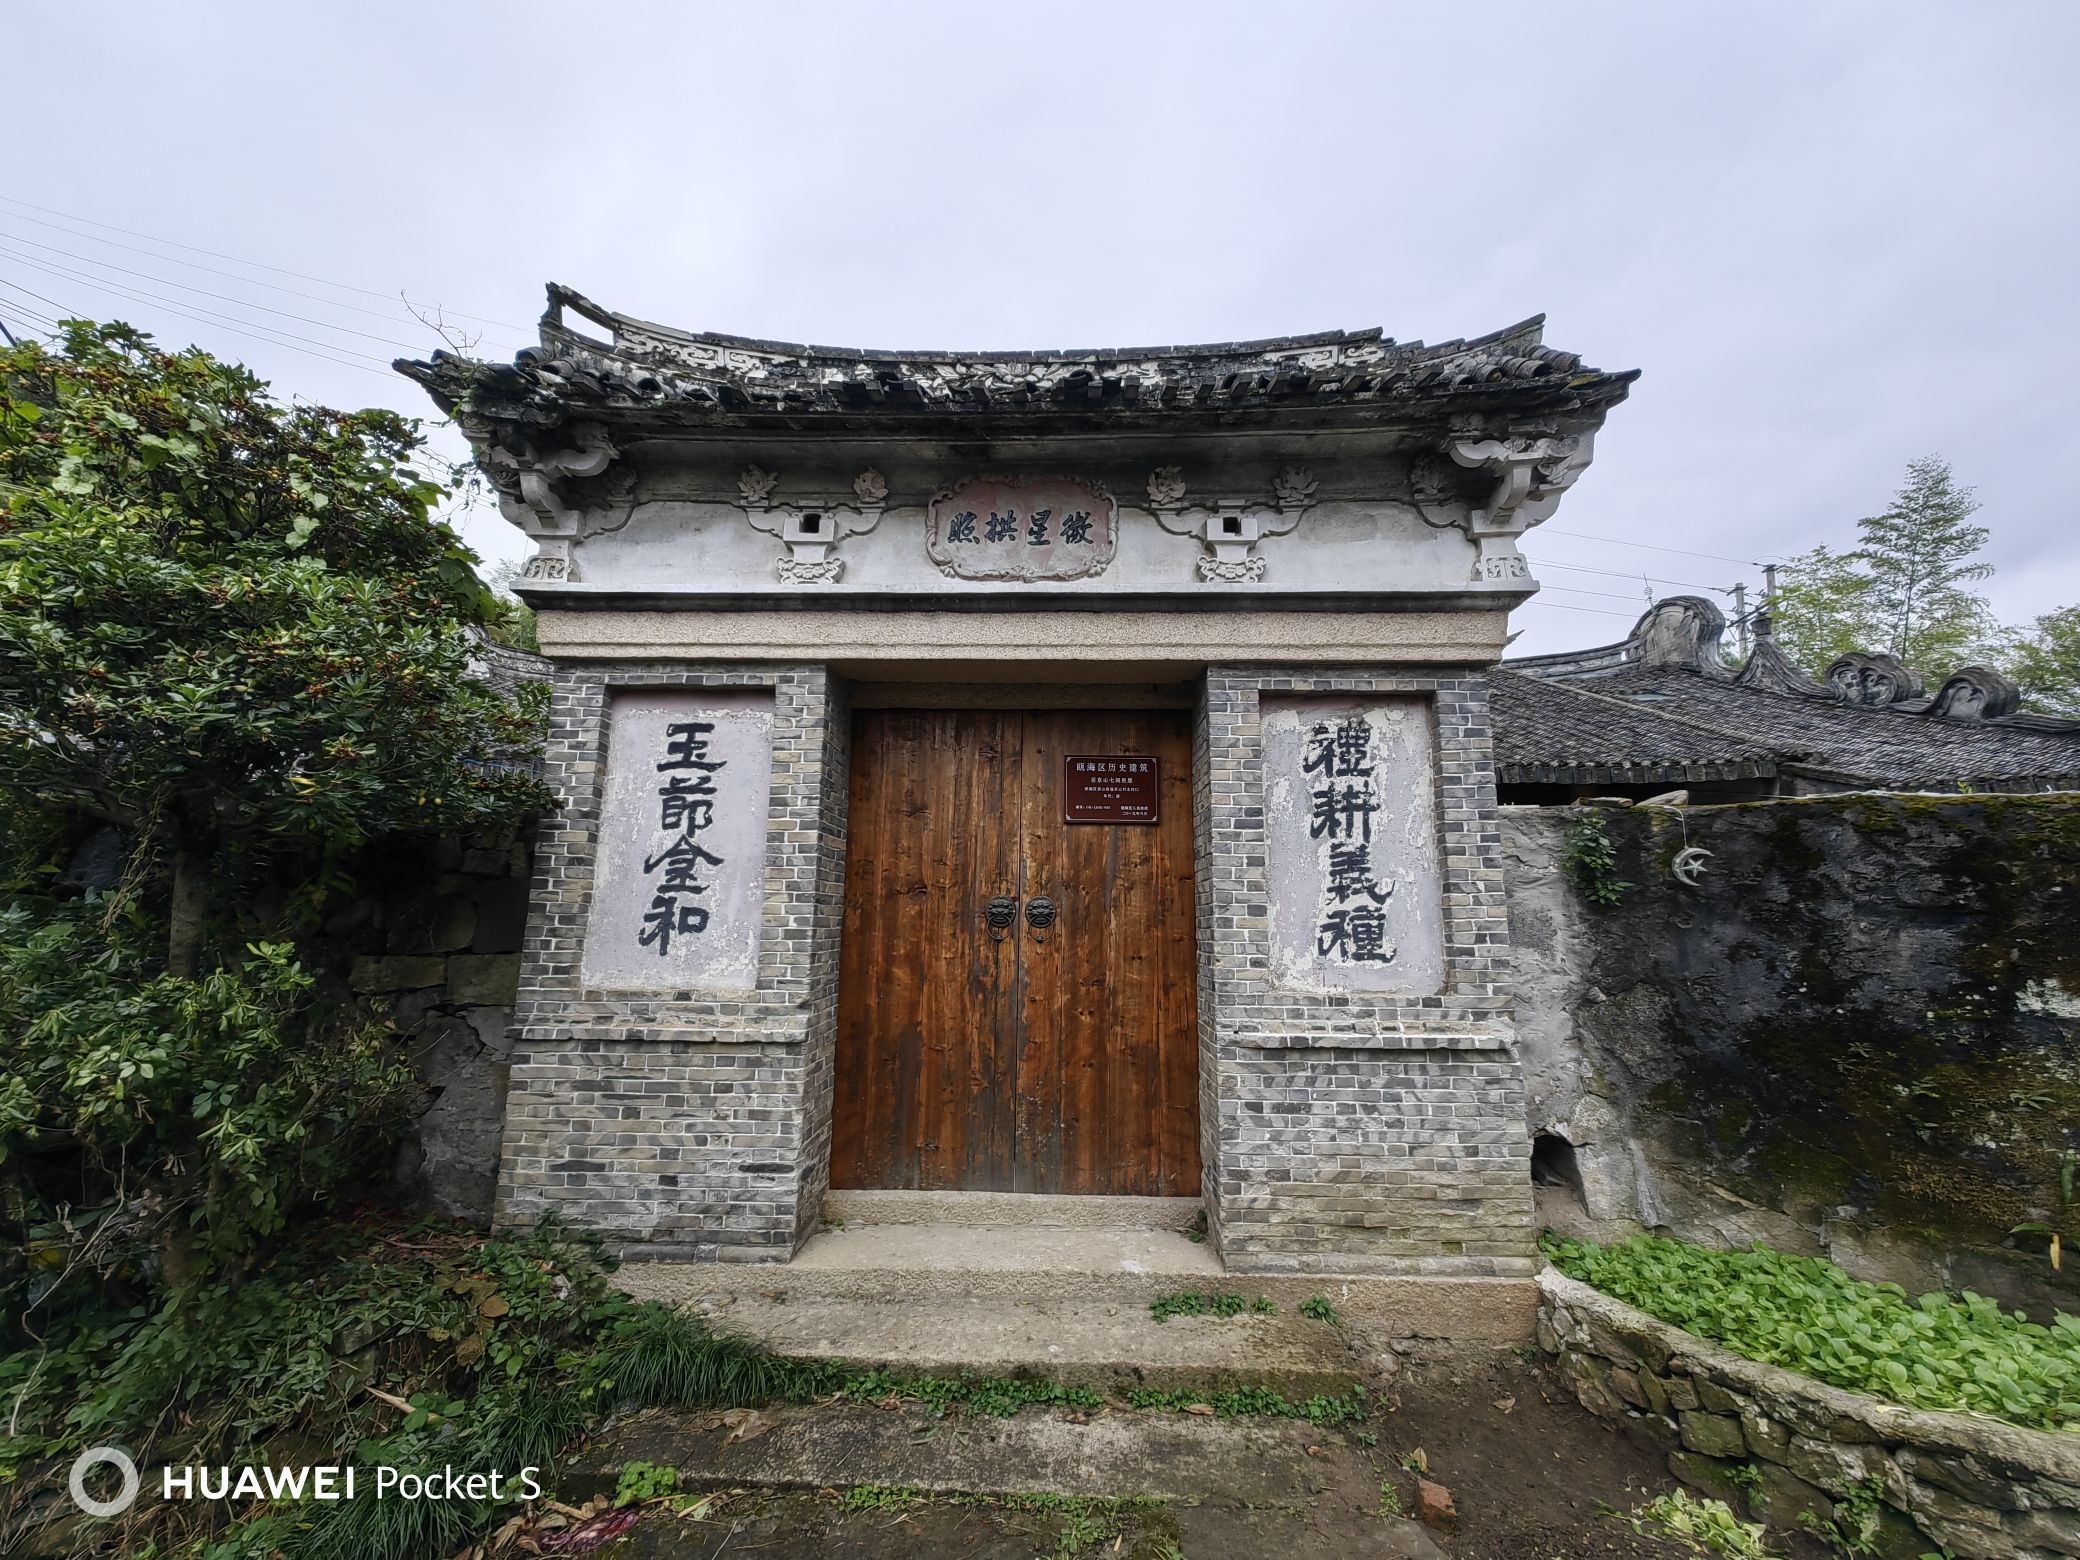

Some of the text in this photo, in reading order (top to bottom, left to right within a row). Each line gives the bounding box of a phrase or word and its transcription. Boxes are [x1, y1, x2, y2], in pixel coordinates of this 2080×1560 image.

[1076, 762, 1149, 773] 瓯海区历史建筑
